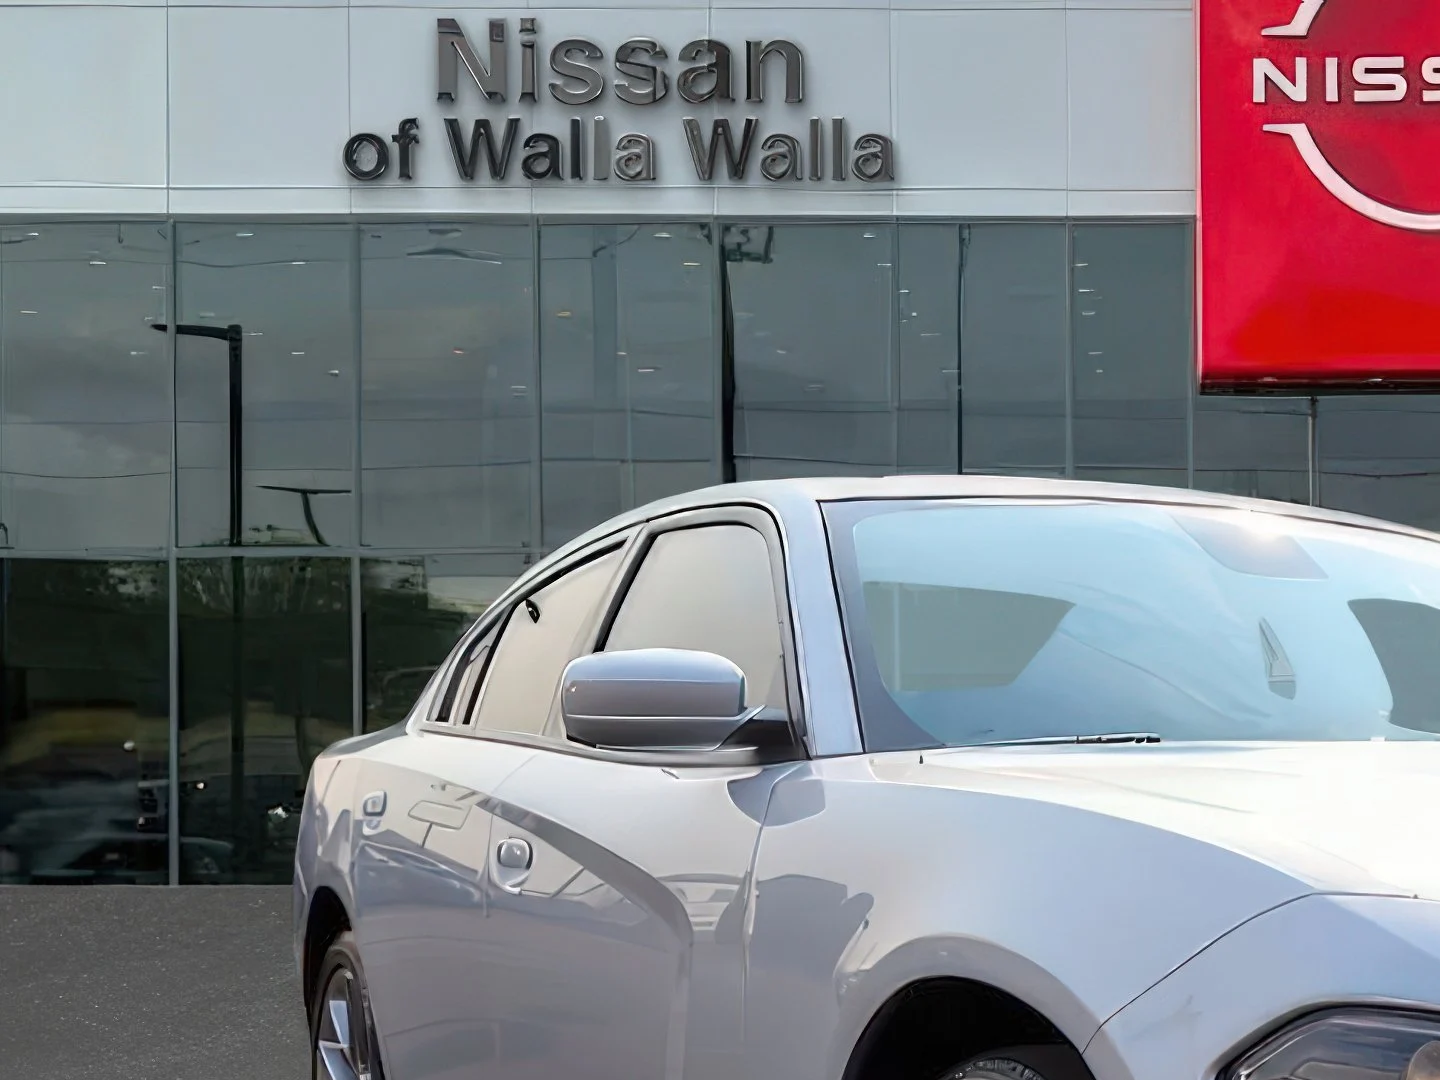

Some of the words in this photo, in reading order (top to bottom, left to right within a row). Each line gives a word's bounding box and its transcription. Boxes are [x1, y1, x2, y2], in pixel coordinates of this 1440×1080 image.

[436, 17, 805, 105] Nissan
[342, 116, 420, 181] of
[443, 116, 657, 182] Walla
[681, 116, 895, 182] Walla
